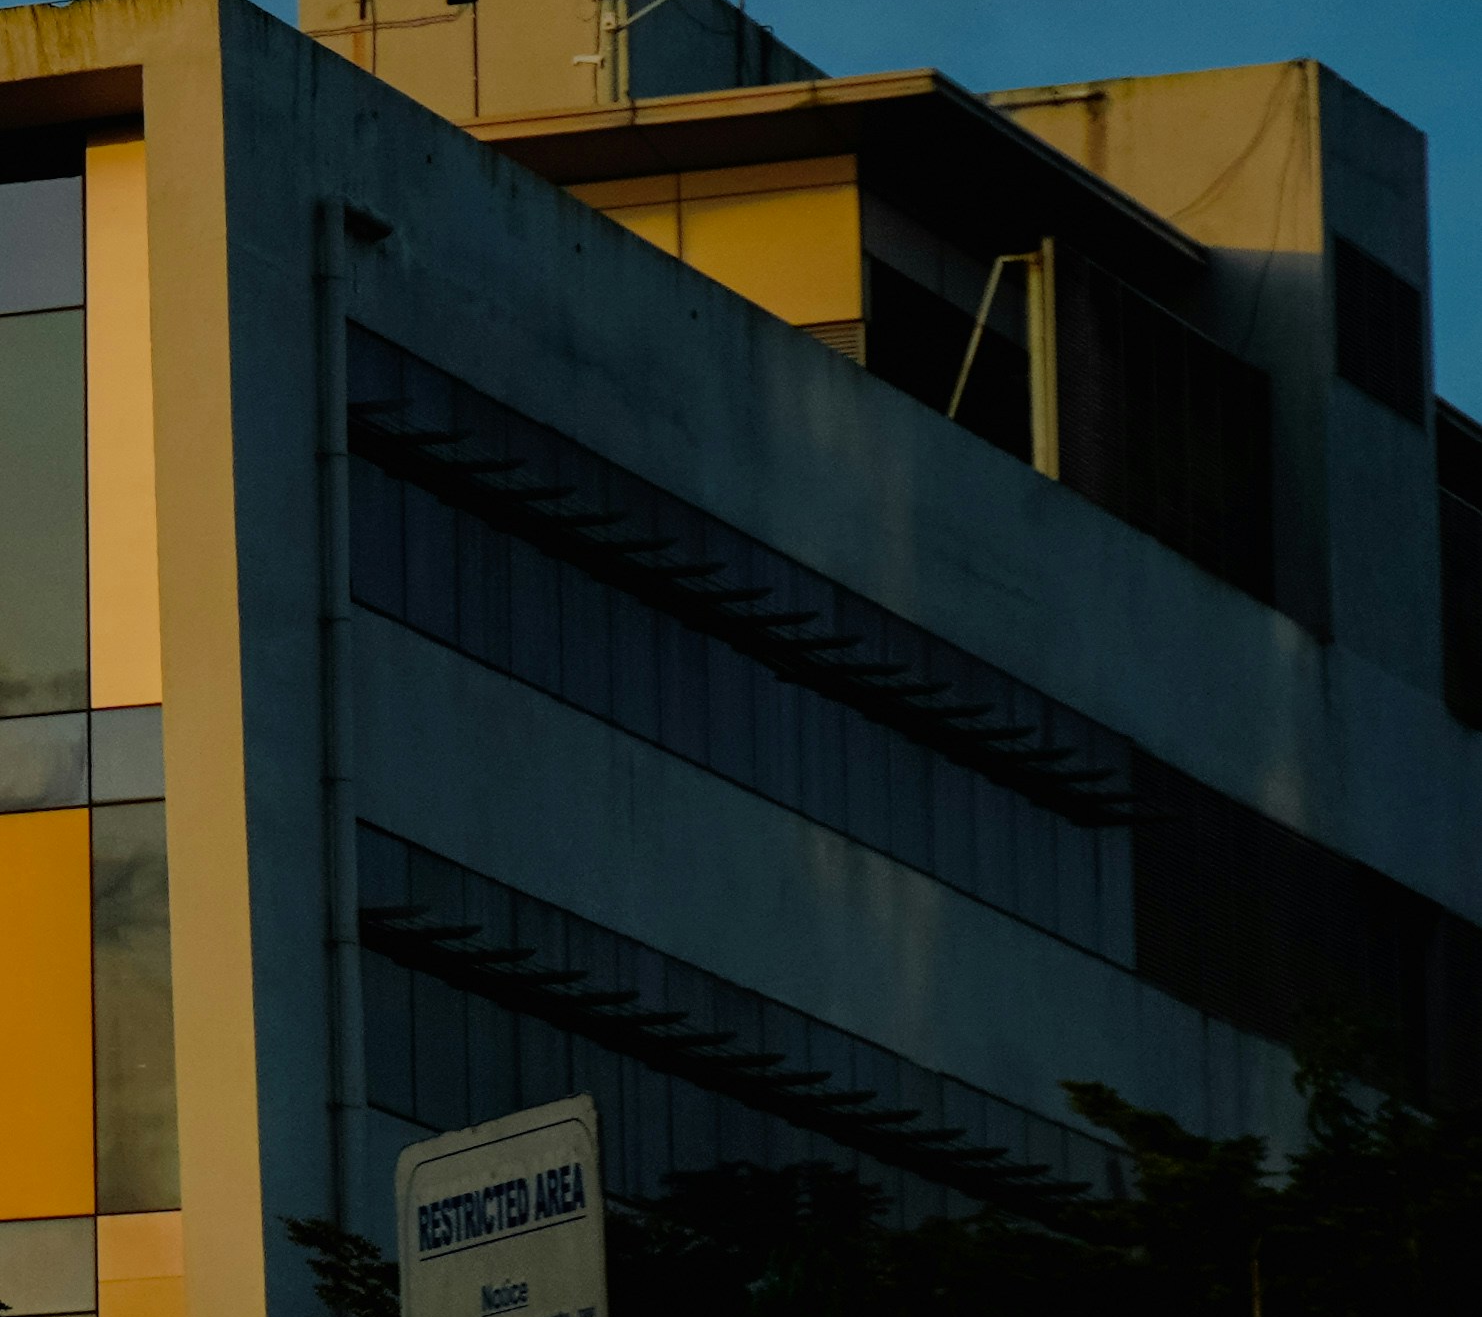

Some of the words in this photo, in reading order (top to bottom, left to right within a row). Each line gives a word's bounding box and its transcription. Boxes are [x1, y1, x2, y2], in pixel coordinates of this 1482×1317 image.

[418, 1178, 528, 1252] RESTRICTED
[535, 1162, 586, 1221] AREA
[481, 1279, 528, 1313] Notice
